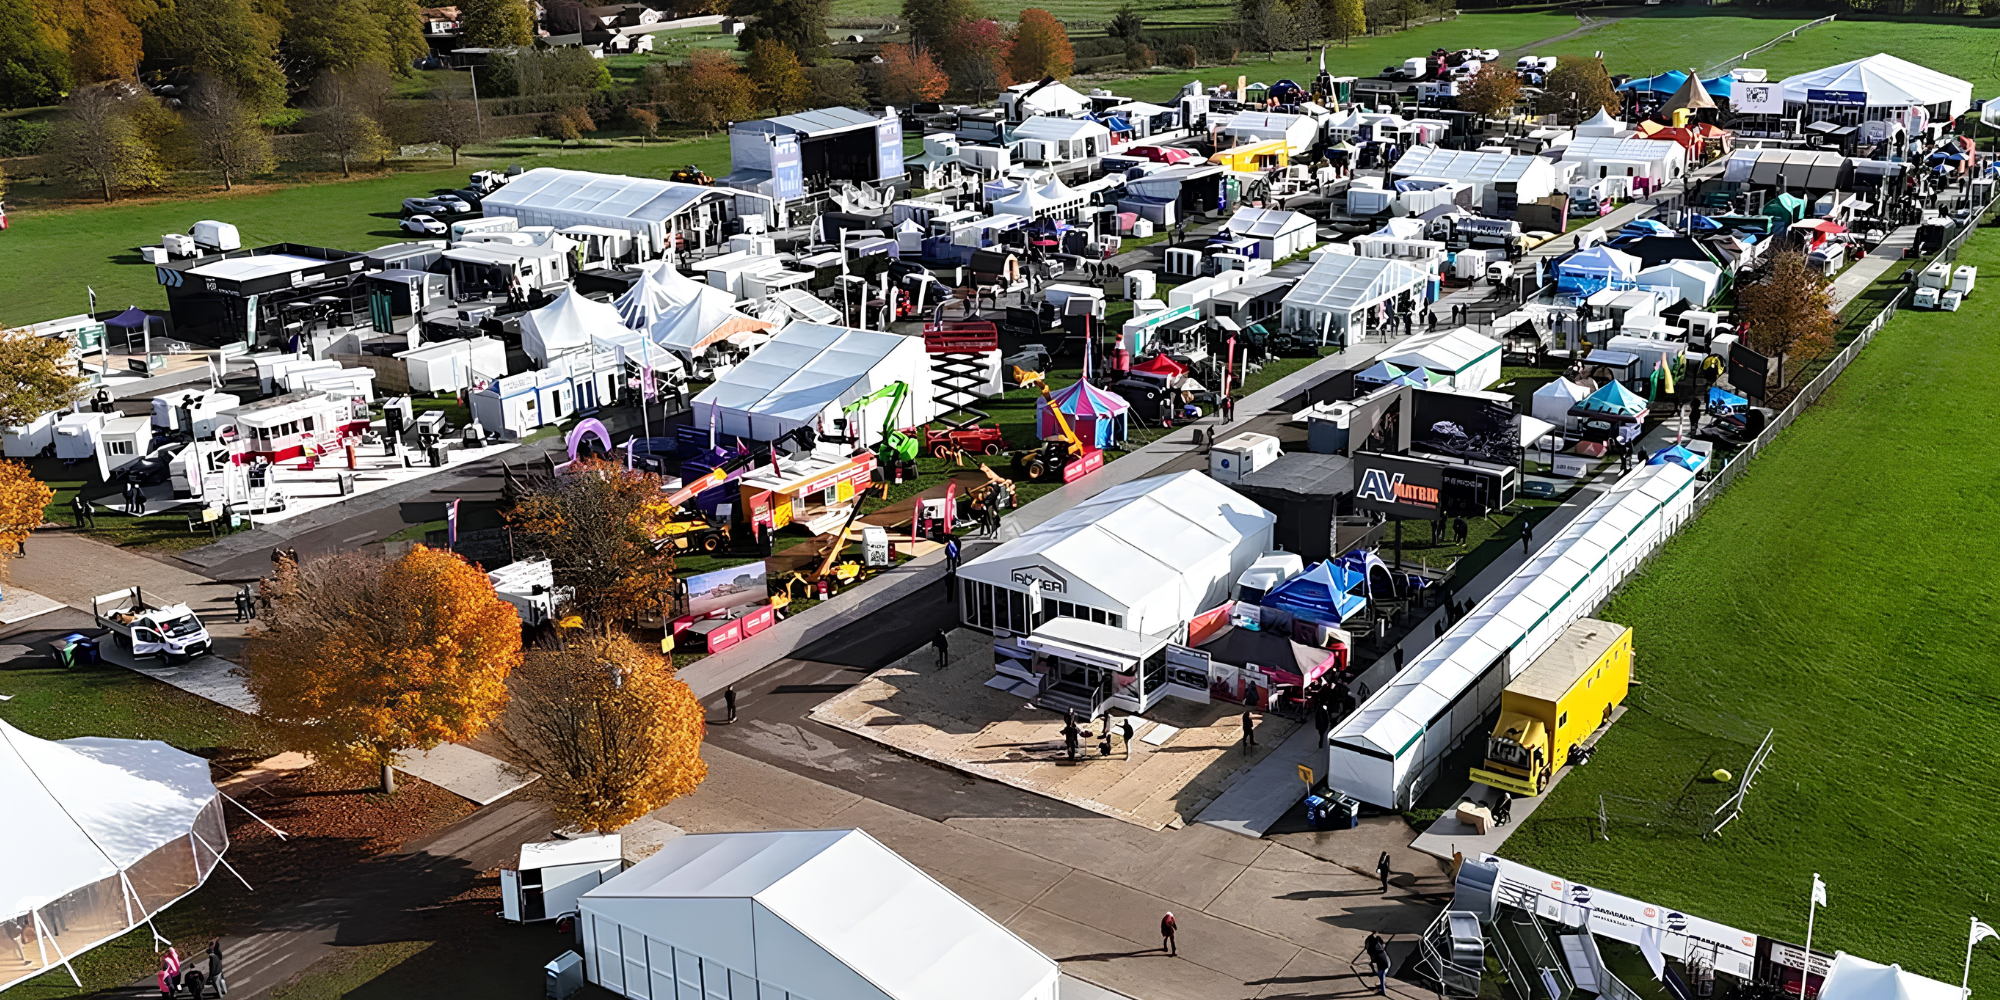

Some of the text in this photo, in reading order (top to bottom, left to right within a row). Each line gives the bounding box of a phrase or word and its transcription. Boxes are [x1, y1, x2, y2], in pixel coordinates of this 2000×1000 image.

[1356, 468, 1405, 503] AV
[1394, 482, 1439, 503] MATRIX
[1014, 572, 1062, 593] RÖER
